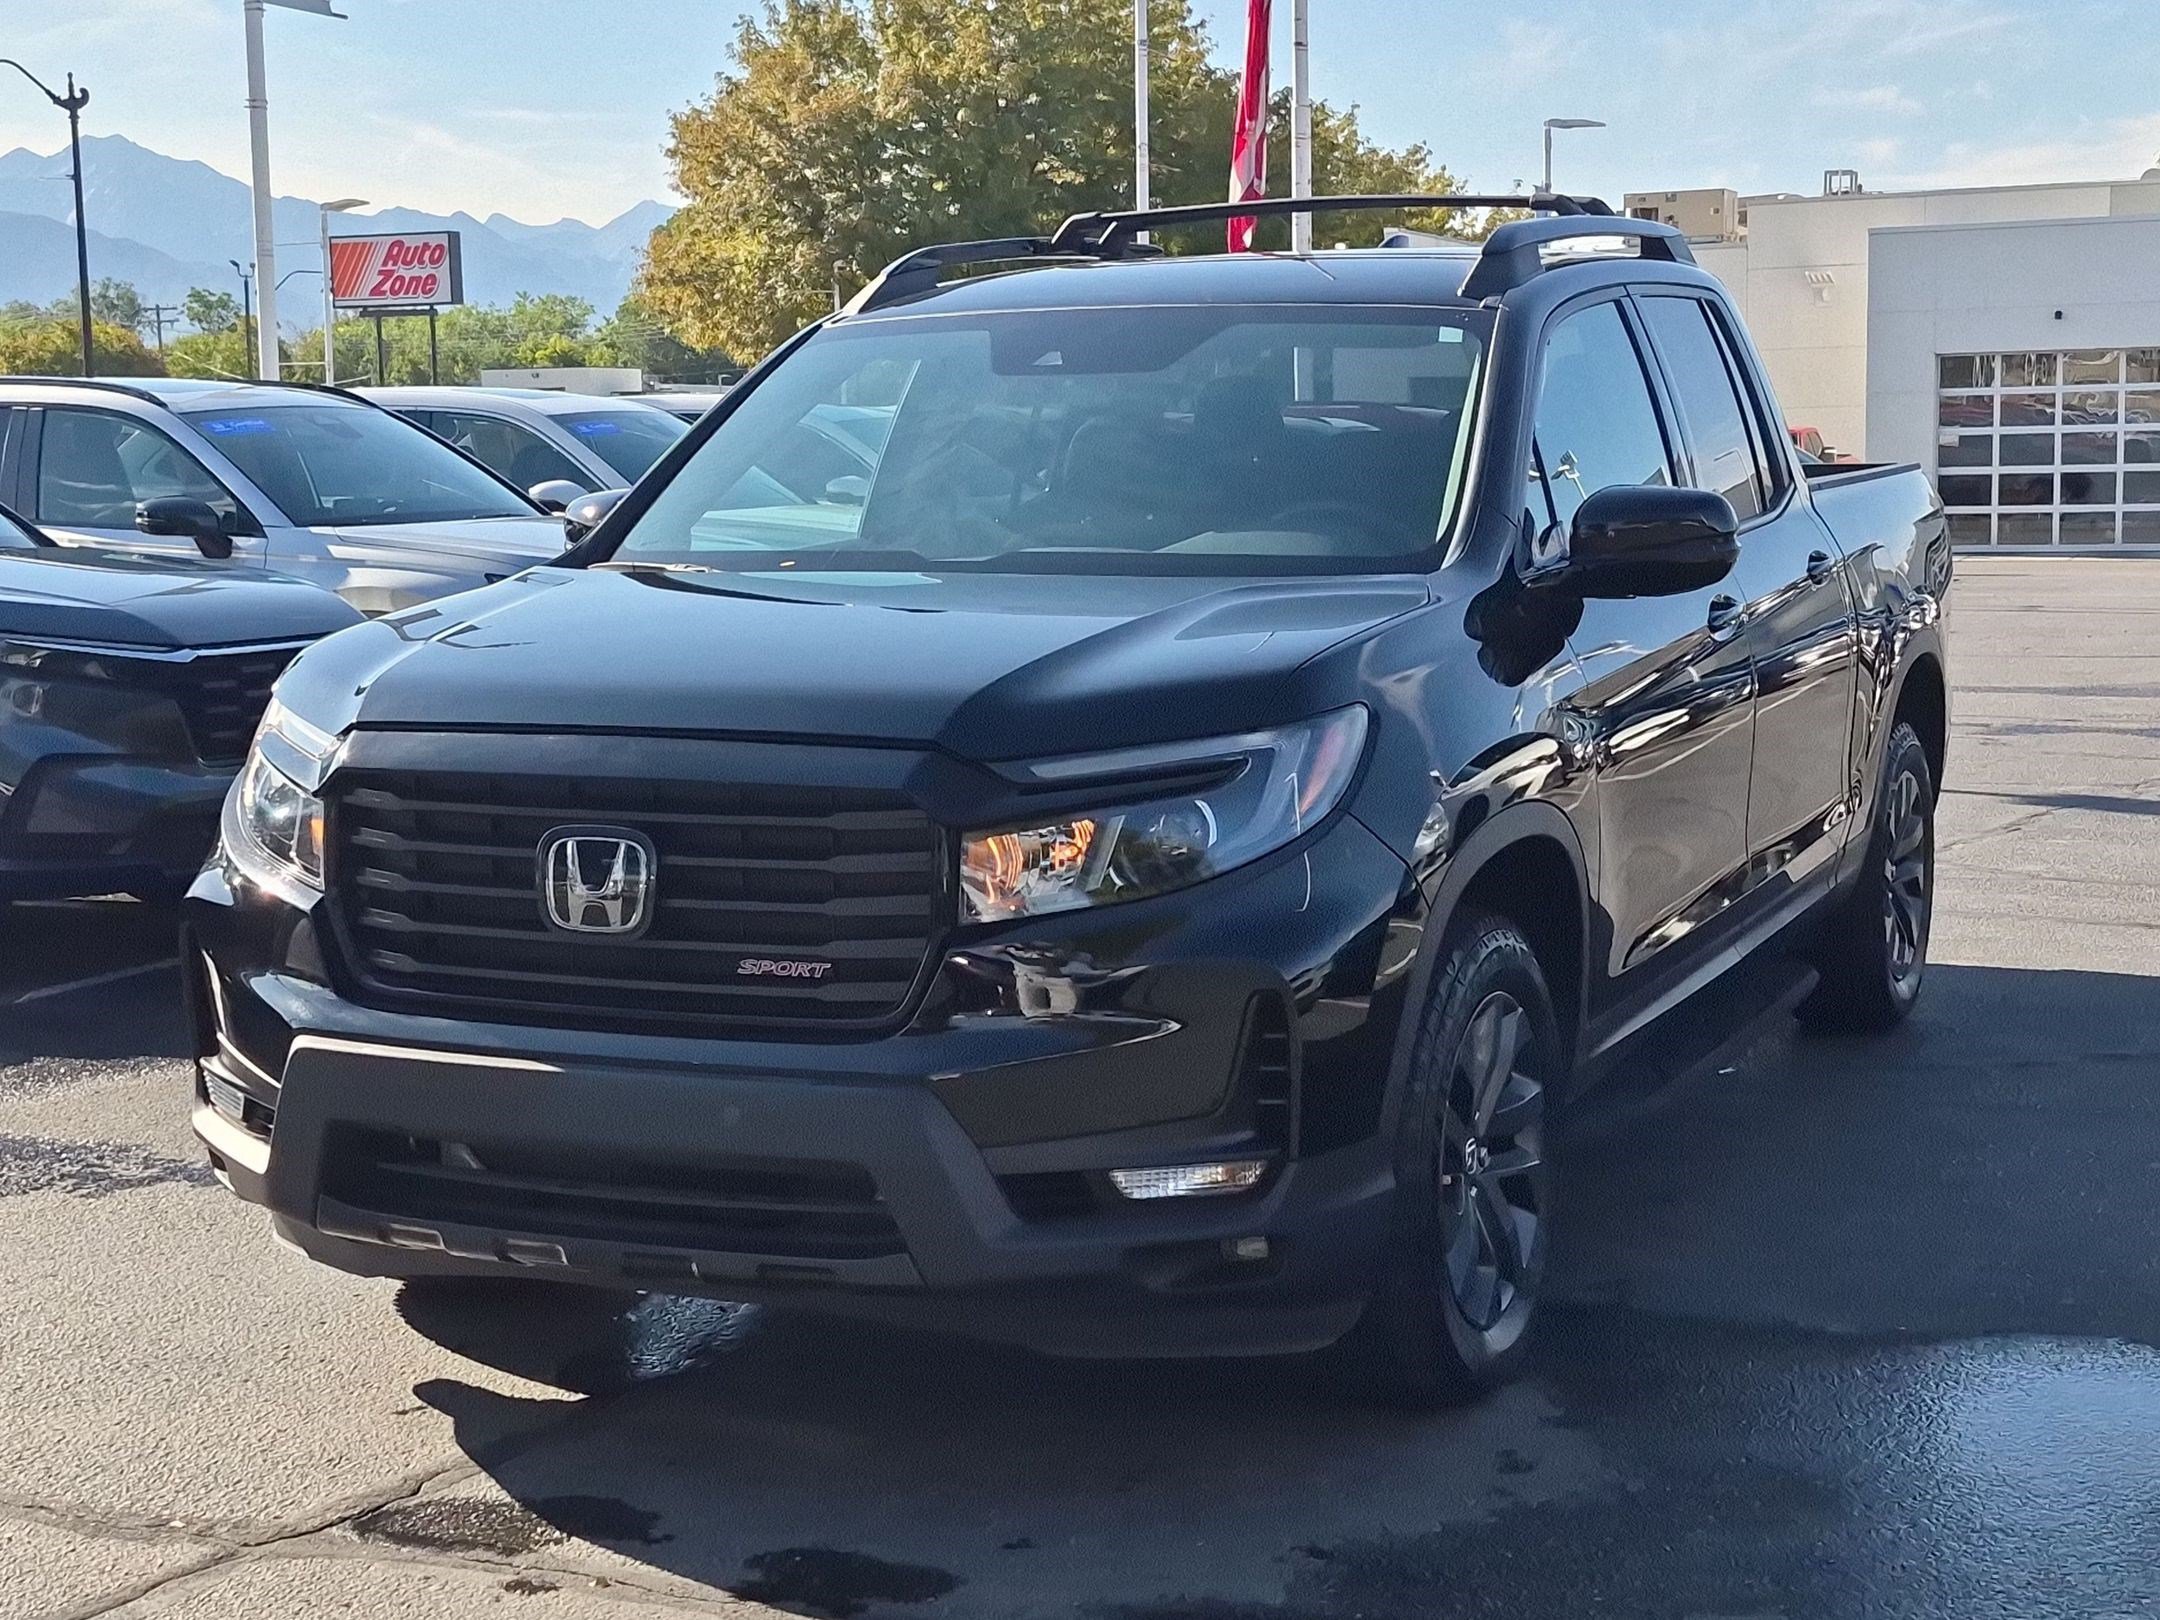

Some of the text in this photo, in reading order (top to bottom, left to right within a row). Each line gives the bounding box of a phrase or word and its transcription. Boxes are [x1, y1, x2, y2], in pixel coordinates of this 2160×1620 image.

[381, 239, 446, 268] Auto
[368, 269, 438, 297] Zone
[737, 959, 831, 978] SPORT
